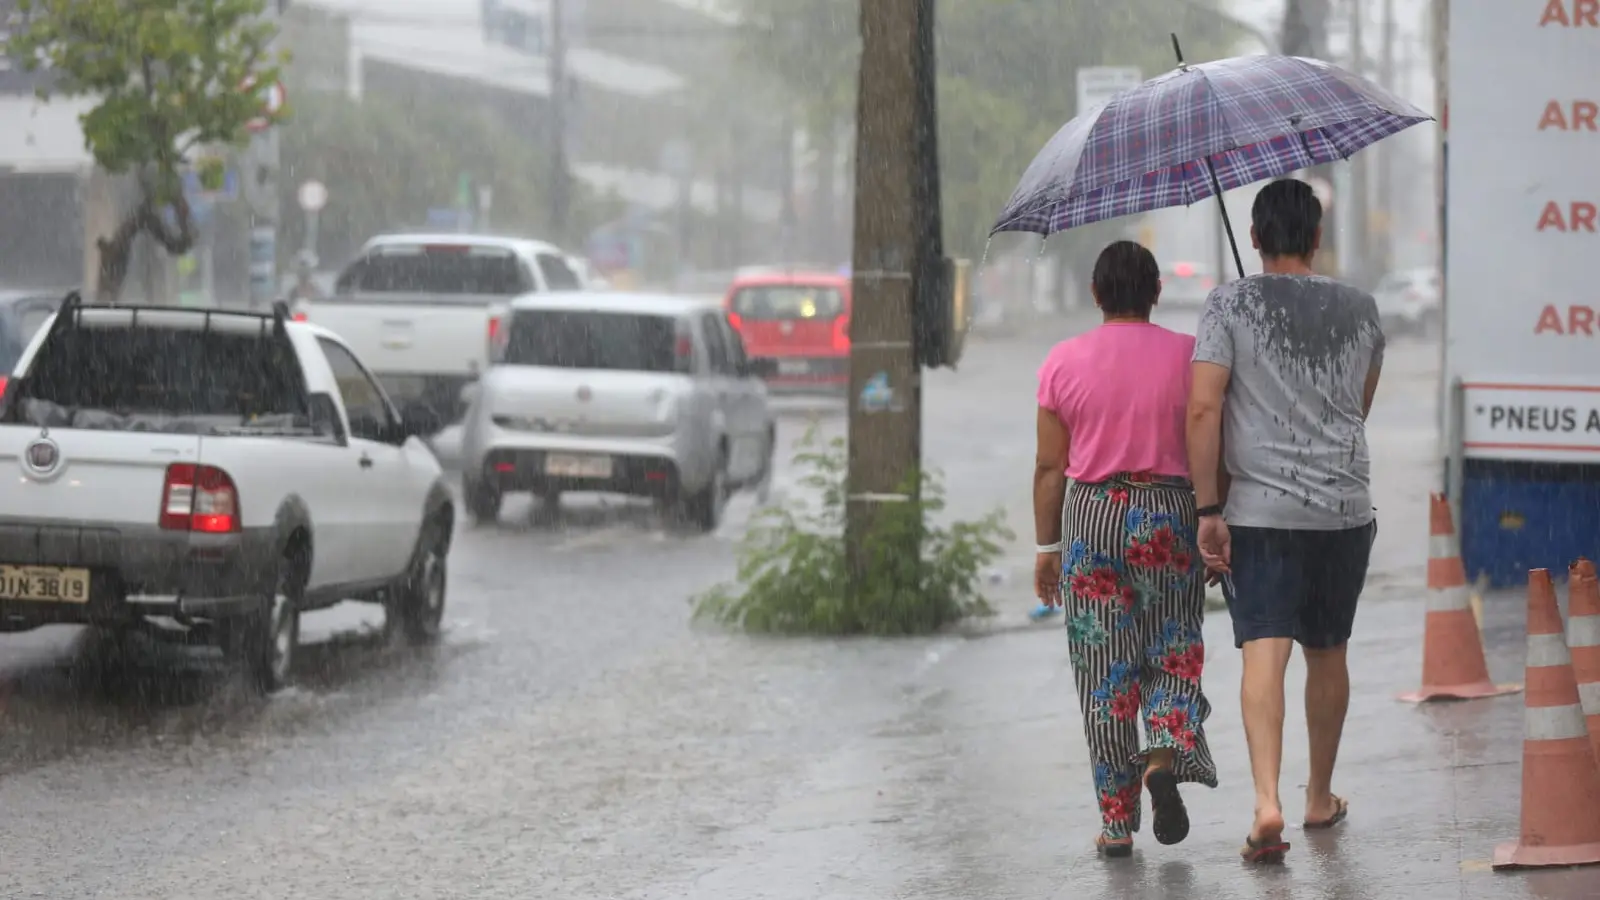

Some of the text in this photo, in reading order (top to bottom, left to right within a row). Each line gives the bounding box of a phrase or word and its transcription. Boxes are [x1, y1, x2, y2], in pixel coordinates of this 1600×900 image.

[1539, 0, 1600, 28] AR
[1537, 99, 1600, 132] AR
[1536, 200, 1600, 232] AR
[1534, 304, 1600, 336] AR
